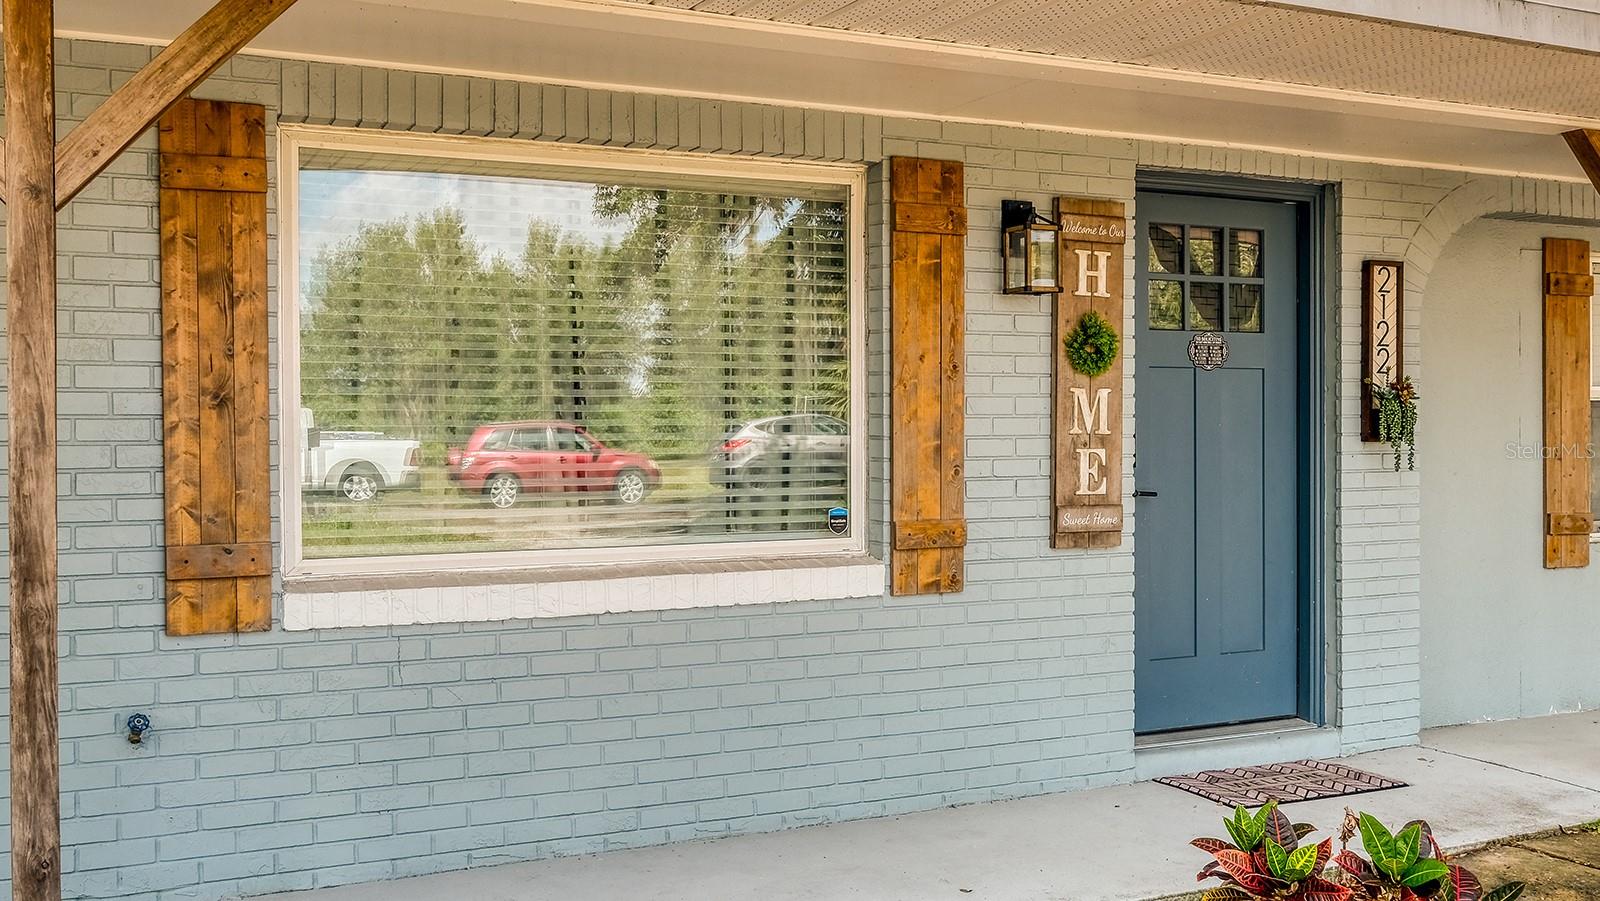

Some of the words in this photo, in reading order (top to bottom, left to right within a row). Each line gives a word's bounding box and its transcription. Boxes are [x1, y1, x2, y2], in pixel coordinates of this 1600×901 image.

[1061, 220, 1097, 236] Welcome
[1098, 224, 1107, 236] to
[1108, 224, 1125, 238] Our
[1062, 512, 1091, 526] Sweet
[1092, 511, 1118, 525] Home
[1225, 772, 1327, 789] WELCOME
